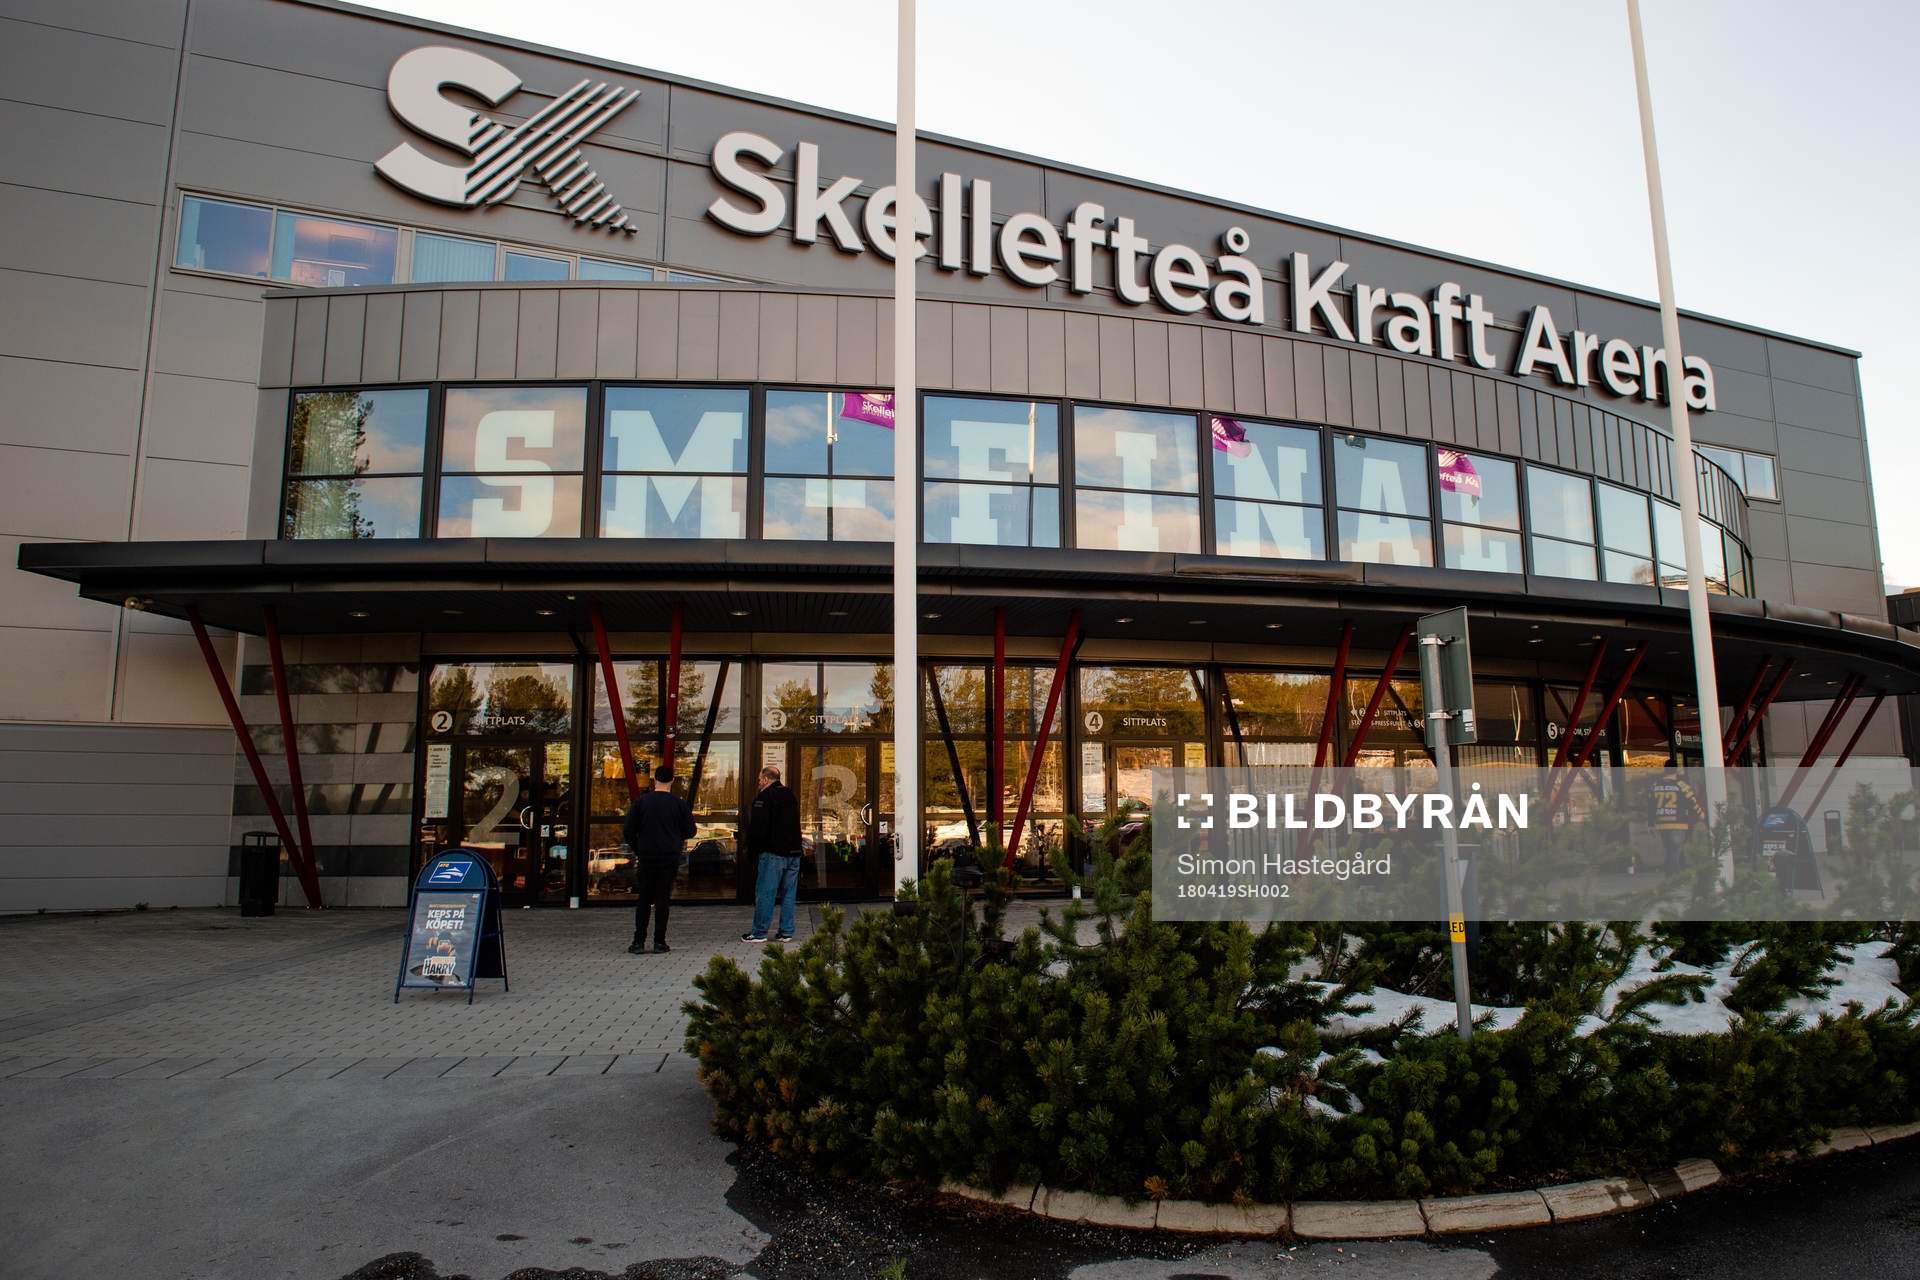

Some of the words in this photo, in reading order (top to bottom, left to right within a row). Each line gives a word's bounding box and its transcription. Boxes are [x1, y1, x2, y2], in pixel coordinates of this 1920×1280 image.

[707, 130, 1265, 326] Skellefteå
[1290, 251, 1497, 370] Kraft
[1514, 304, 1717, 412] Arena
[1122, 717, 1167, 727] SITTPLATS
[468, 766, 520, 845] 2
[1654, 791, 1678, 808] 72
[427, 909, 451, 919] KEPS
[452, 907, 465, 919] PÅ
[425, 918, 464, 929] KÖPET!
[1449, 921, 1465, 933] ED
[423, 960, 454, 975] HARRY
